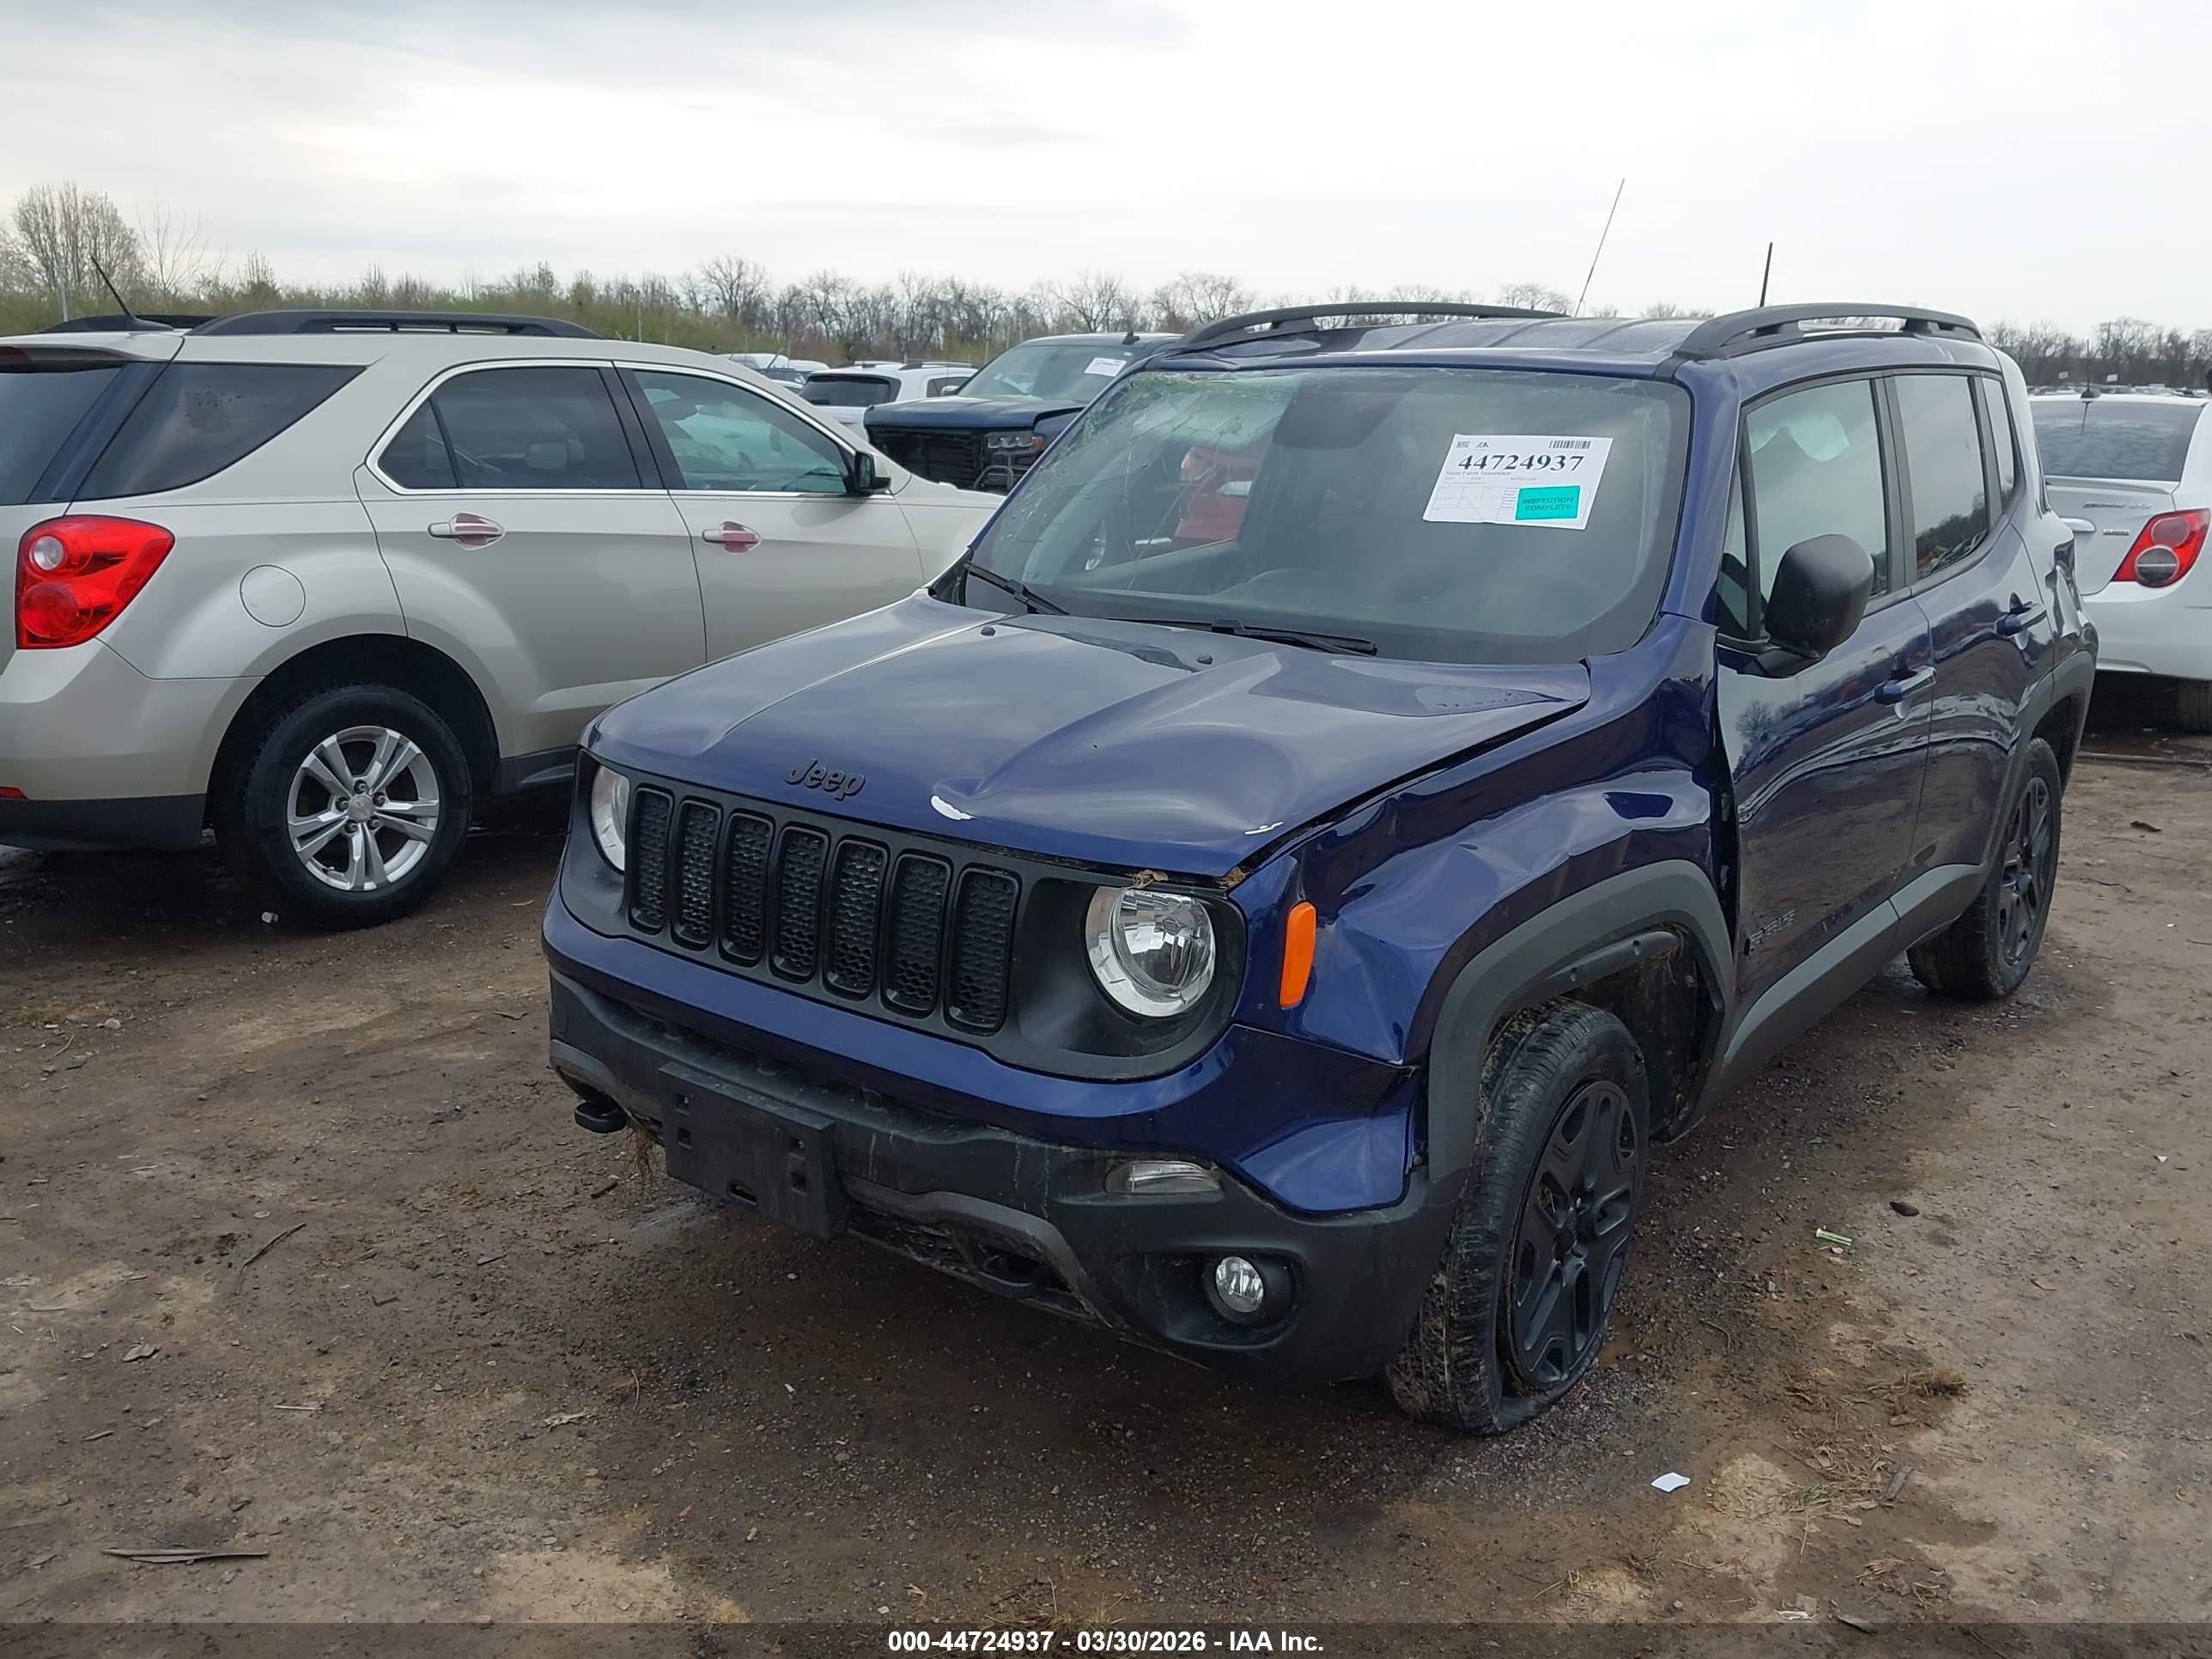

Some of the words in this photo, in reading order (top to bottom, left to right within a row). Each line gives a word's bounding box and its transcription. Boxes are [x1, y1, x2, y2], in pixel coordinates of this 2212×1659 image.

[1457, 454, 1585, 471] 44724937
[1522, 496, 1574, 505] INSPECTION
[785, 759, 866, 802] Jeep
